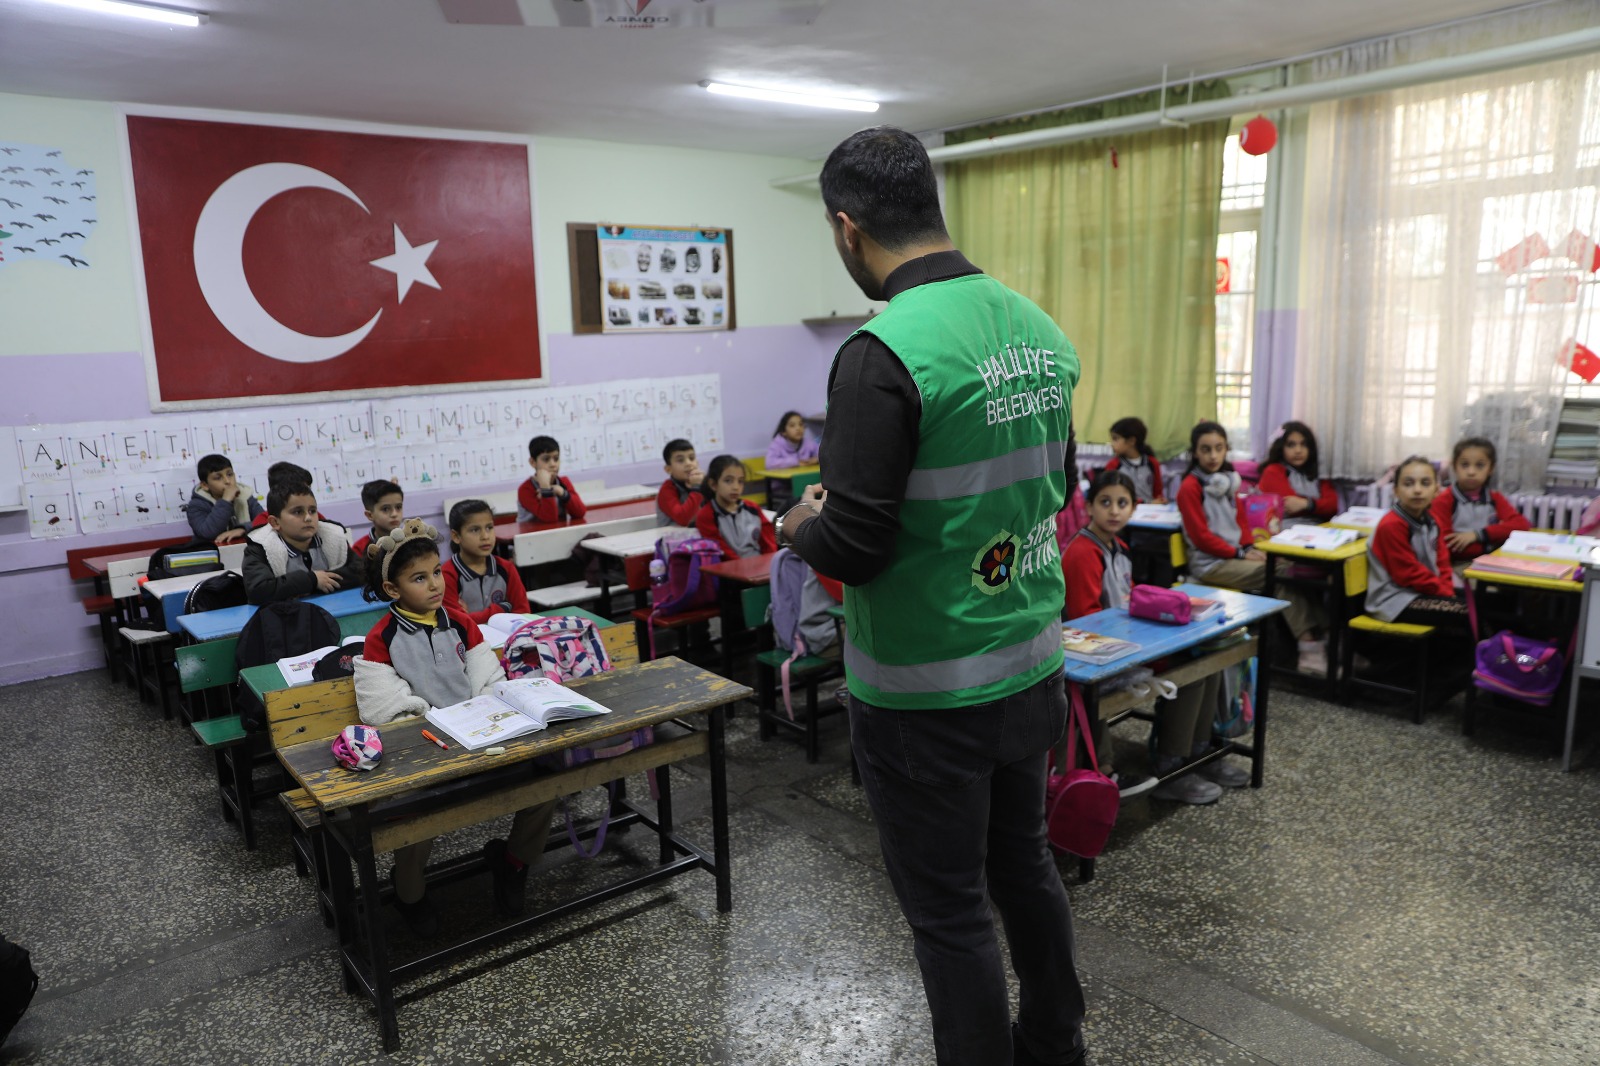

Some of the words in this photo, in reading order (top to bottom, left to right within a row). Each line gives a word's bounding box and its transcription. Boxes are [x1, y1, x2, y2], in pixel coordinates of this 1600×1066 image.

[976, 341, 1056, 393] HALİLİYE
[986, 380, 1063, 426] BELEDİYESİ
[35, 443, 52, 462] A
[79, 440, 98, 460] N
[124, 436, 138, 457] E
[165, 435, 177, 454] T
[245, 428, 258, 446] L
[316, 422, 328, 438] K
[348, 417, 361, 433] U
[1020, 538, 1057, 578] ATIK
